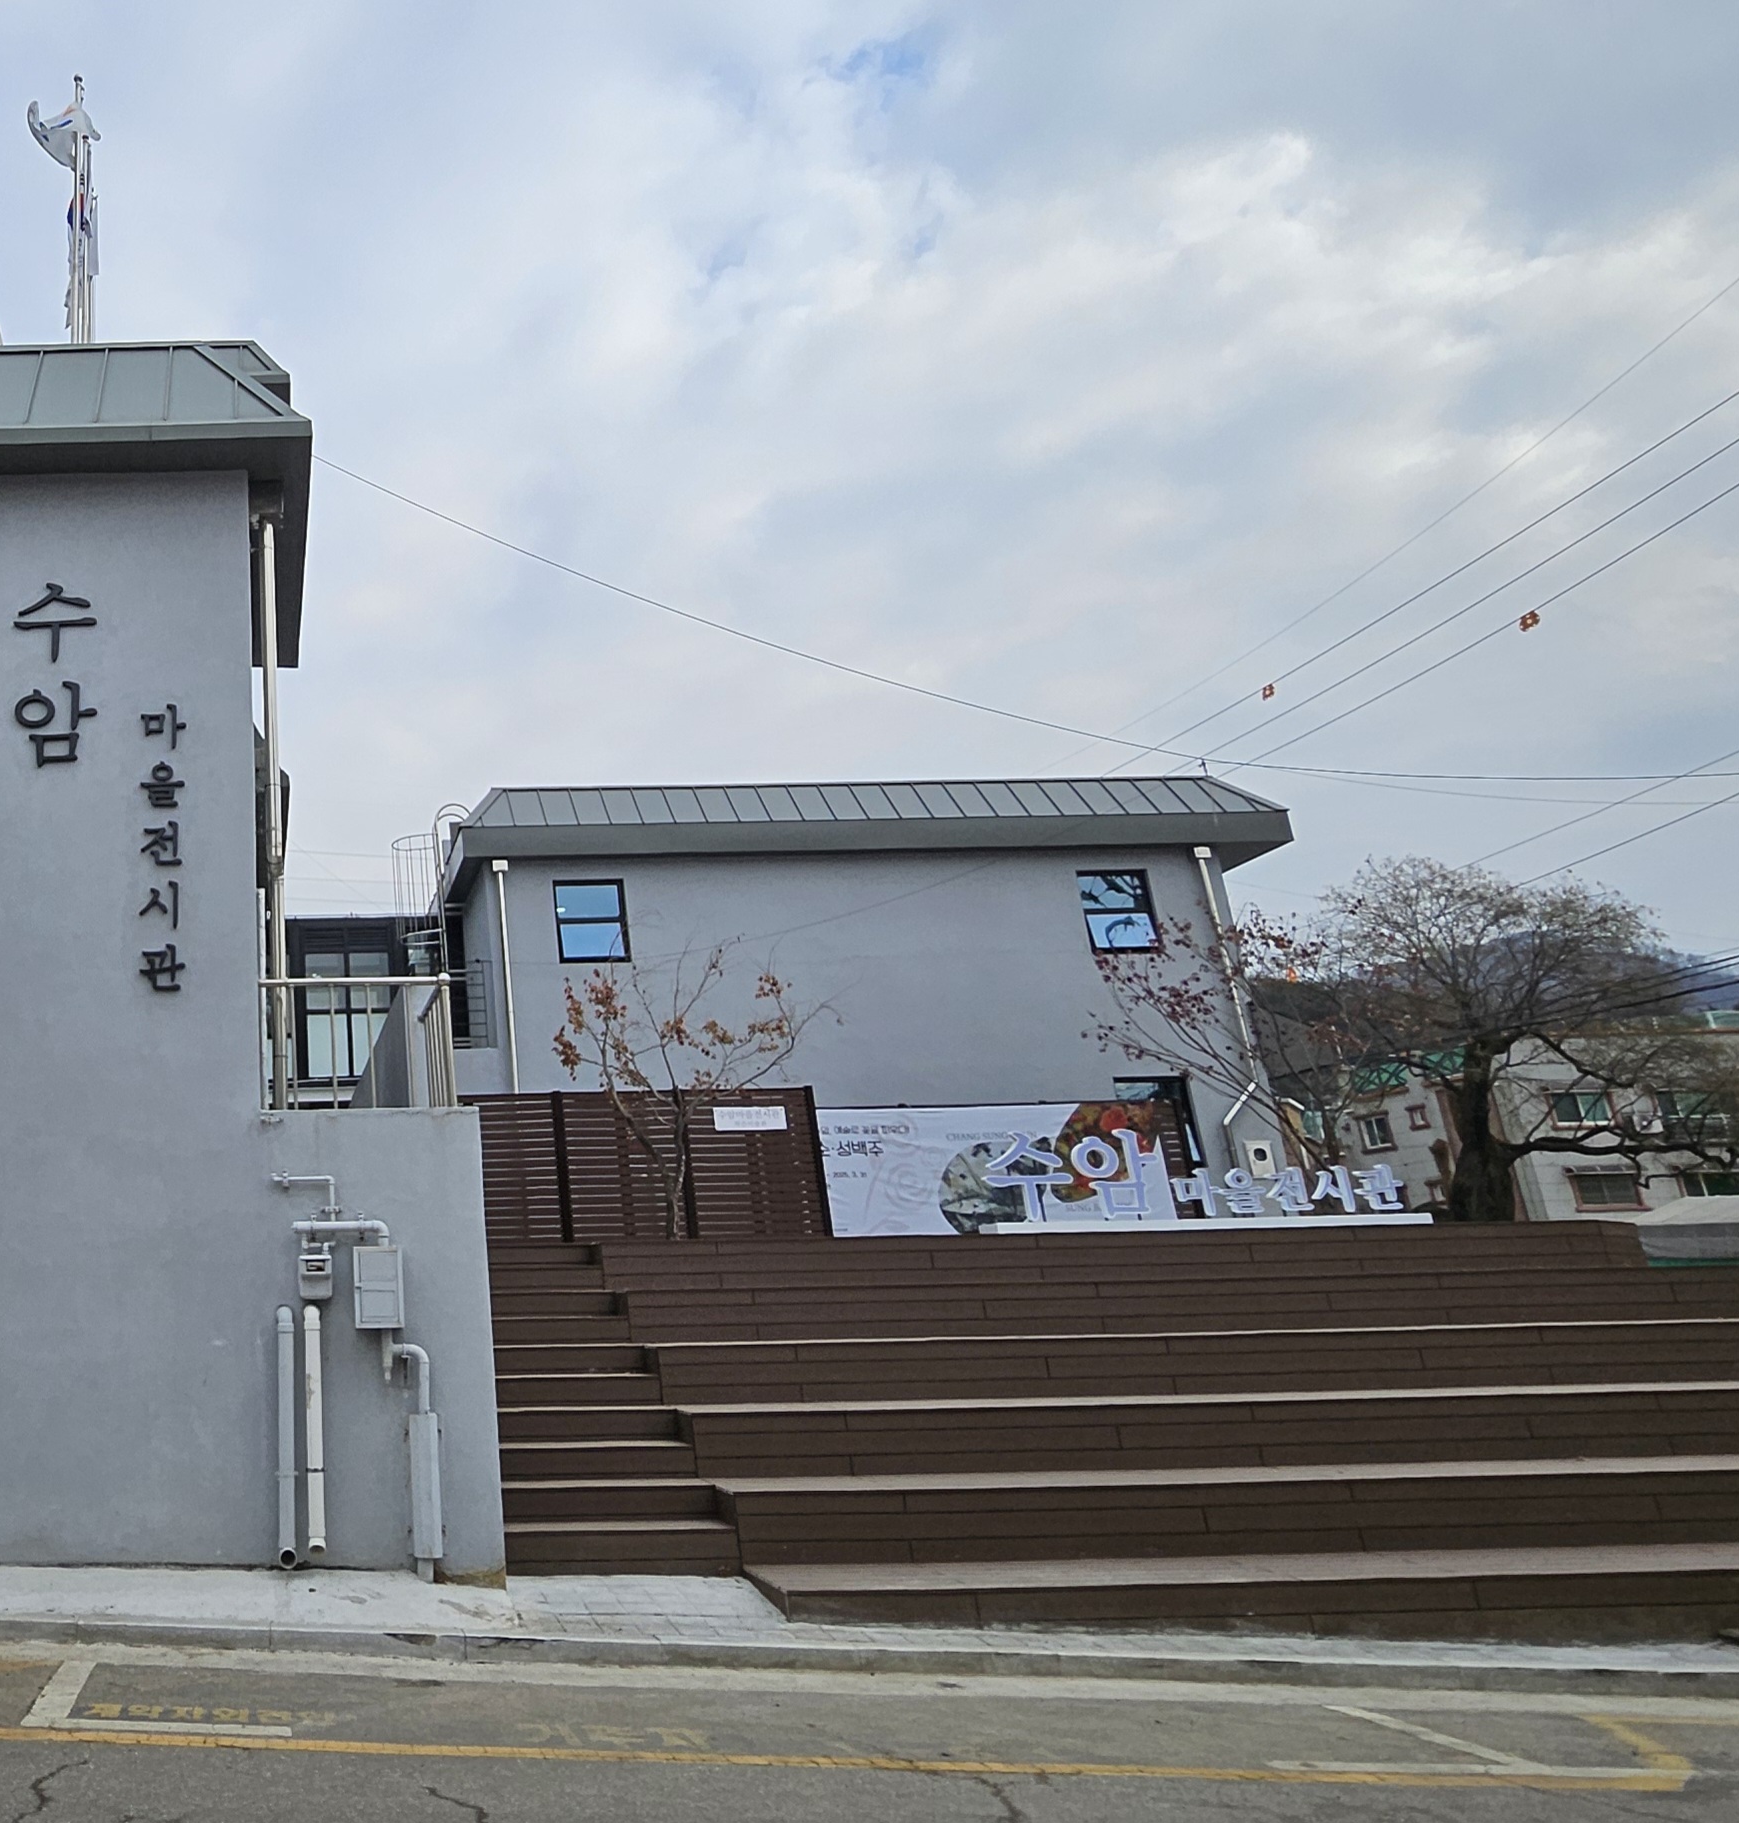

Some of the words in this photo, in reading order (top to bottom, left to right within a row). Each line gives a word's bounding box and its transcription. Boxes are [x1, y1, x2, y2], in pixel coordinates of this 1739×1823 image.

[13, 581, 98, 767] 수암
[139, 704, 187, 993] 마을전시관
[945, 1132, 981, 1142] CHANG
[981, 1128, 1159, 1222] 수암
[1169, 1163, 1404, 1217] 마을전시관
